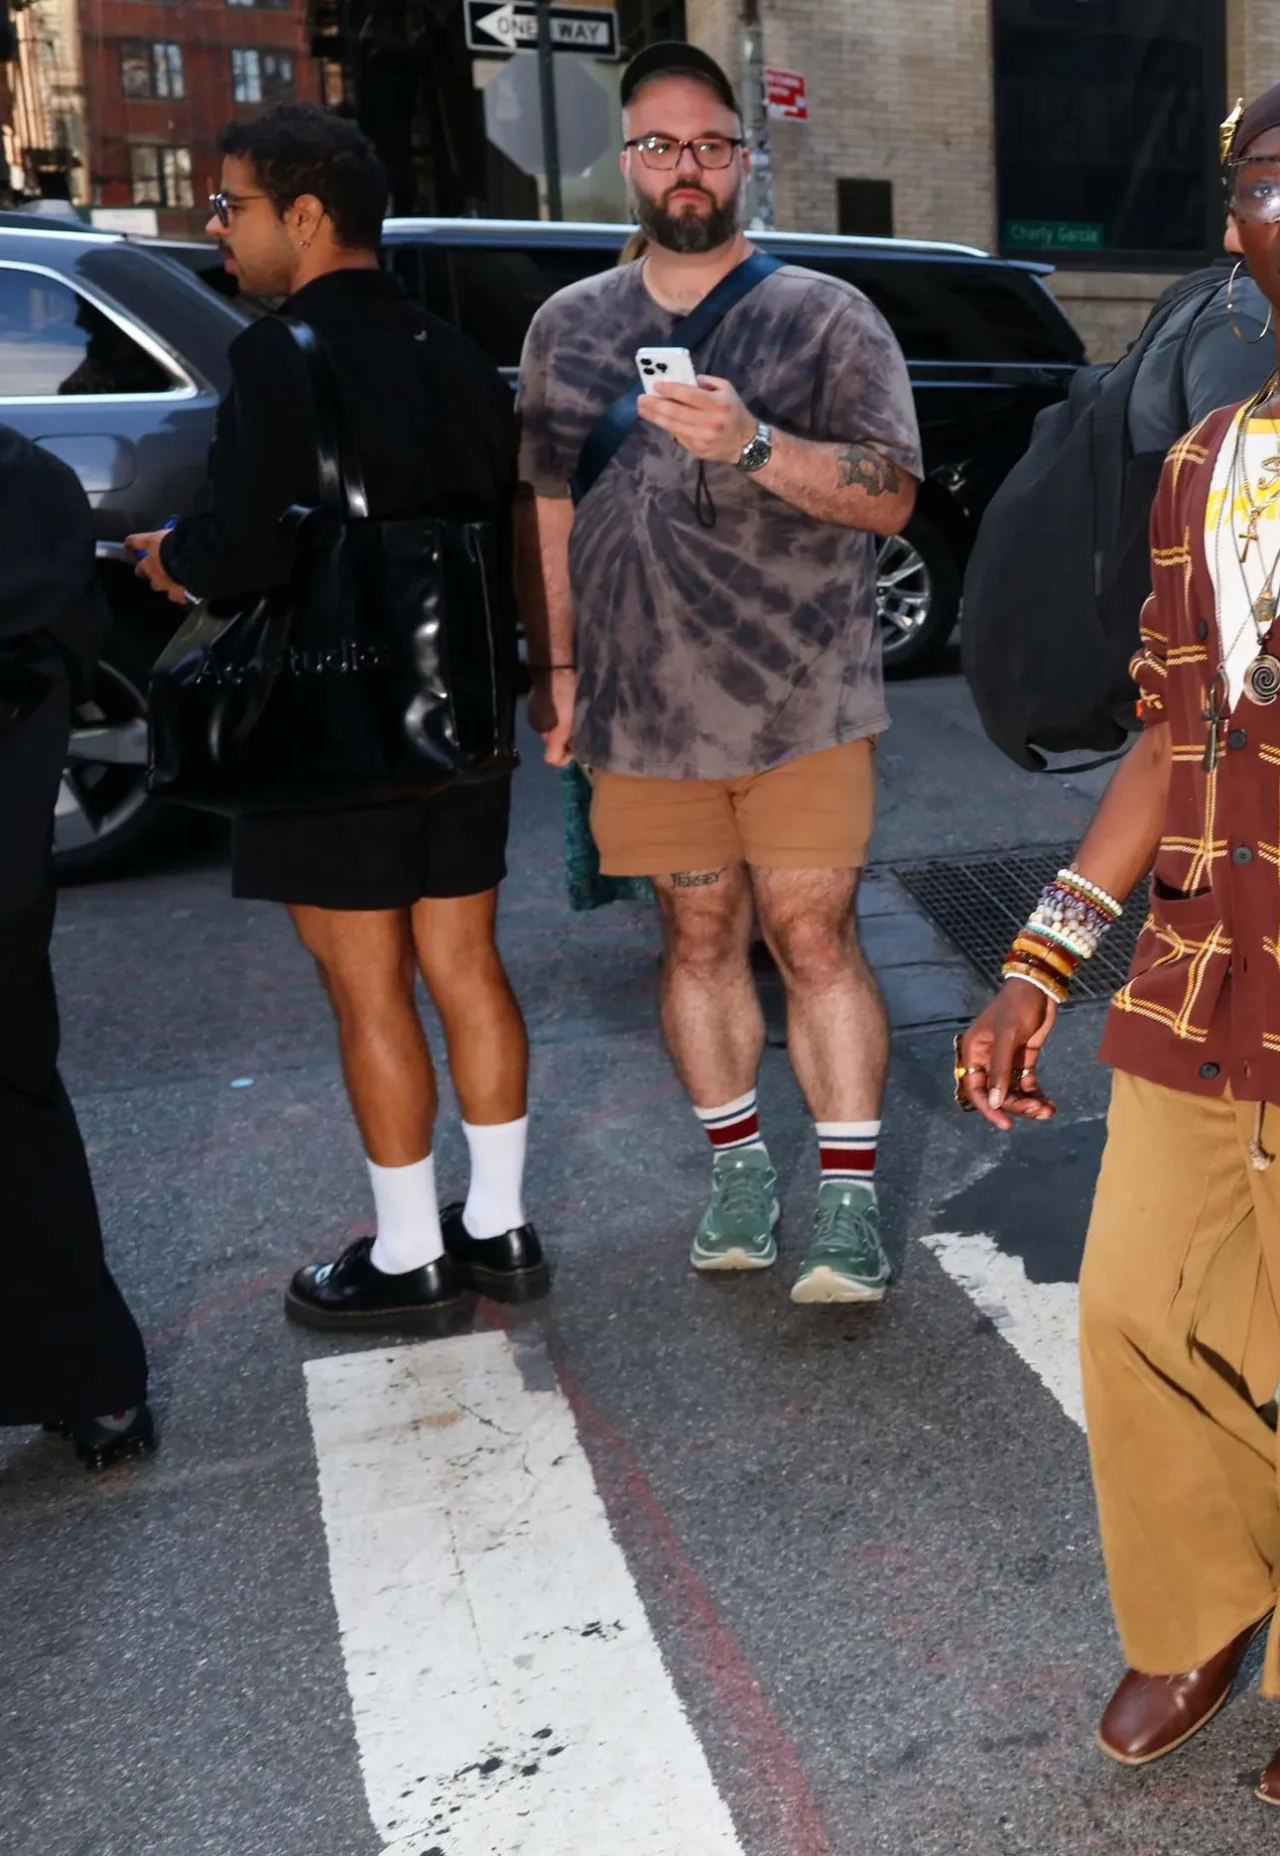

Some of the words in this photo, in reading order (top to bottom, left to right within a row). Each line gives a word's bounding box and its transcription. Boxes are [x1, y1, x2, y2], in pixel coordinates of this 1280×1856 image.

[495, 16, 535, 37] ONE
[558, 22, 600, 41] WAY
[286, 637, 393, 677] tudios
